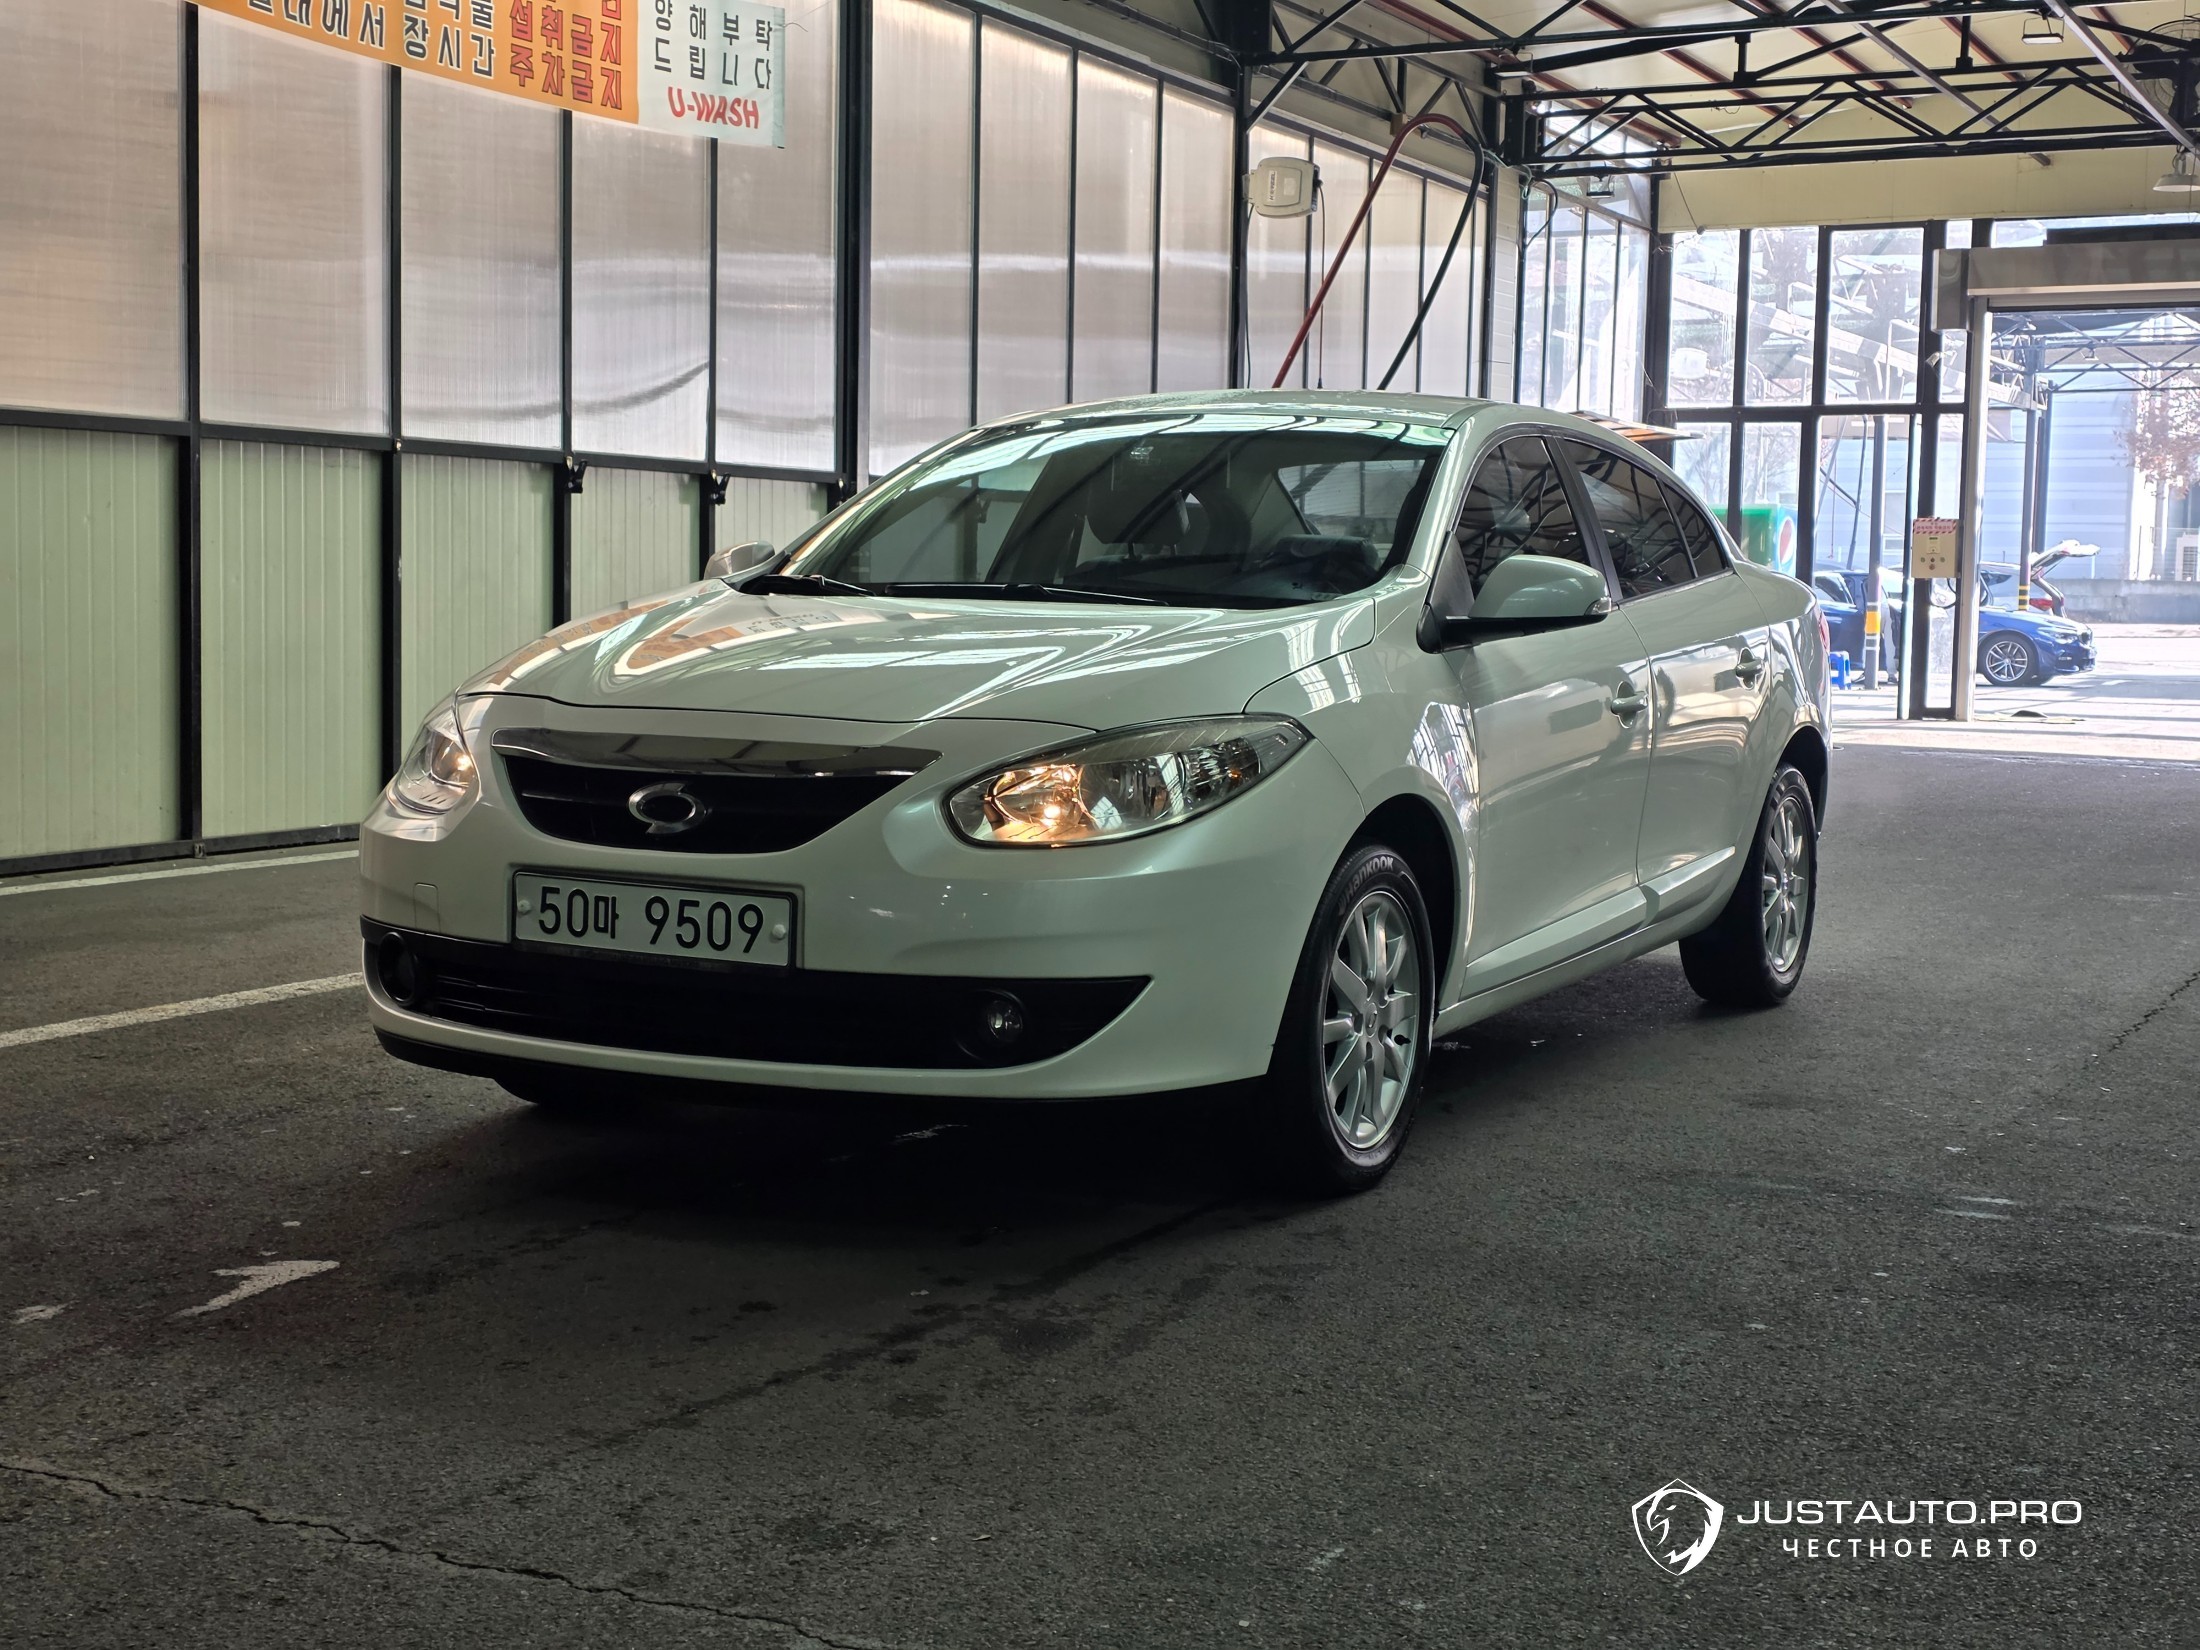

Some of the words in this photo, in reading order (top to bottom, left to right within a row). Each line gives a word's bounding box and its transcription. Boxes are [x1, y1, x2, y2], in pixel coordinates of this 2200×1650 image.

[404, 14, 495, 78] 장시간
[510, 43, 622, 110] 주차금지
[510, 0, 621, 65] 섭취금지
[668, 86, 759, 129] U-WASH
[538, 886, 619, 939] 50마
[644, 895, 764, 953] 9509
